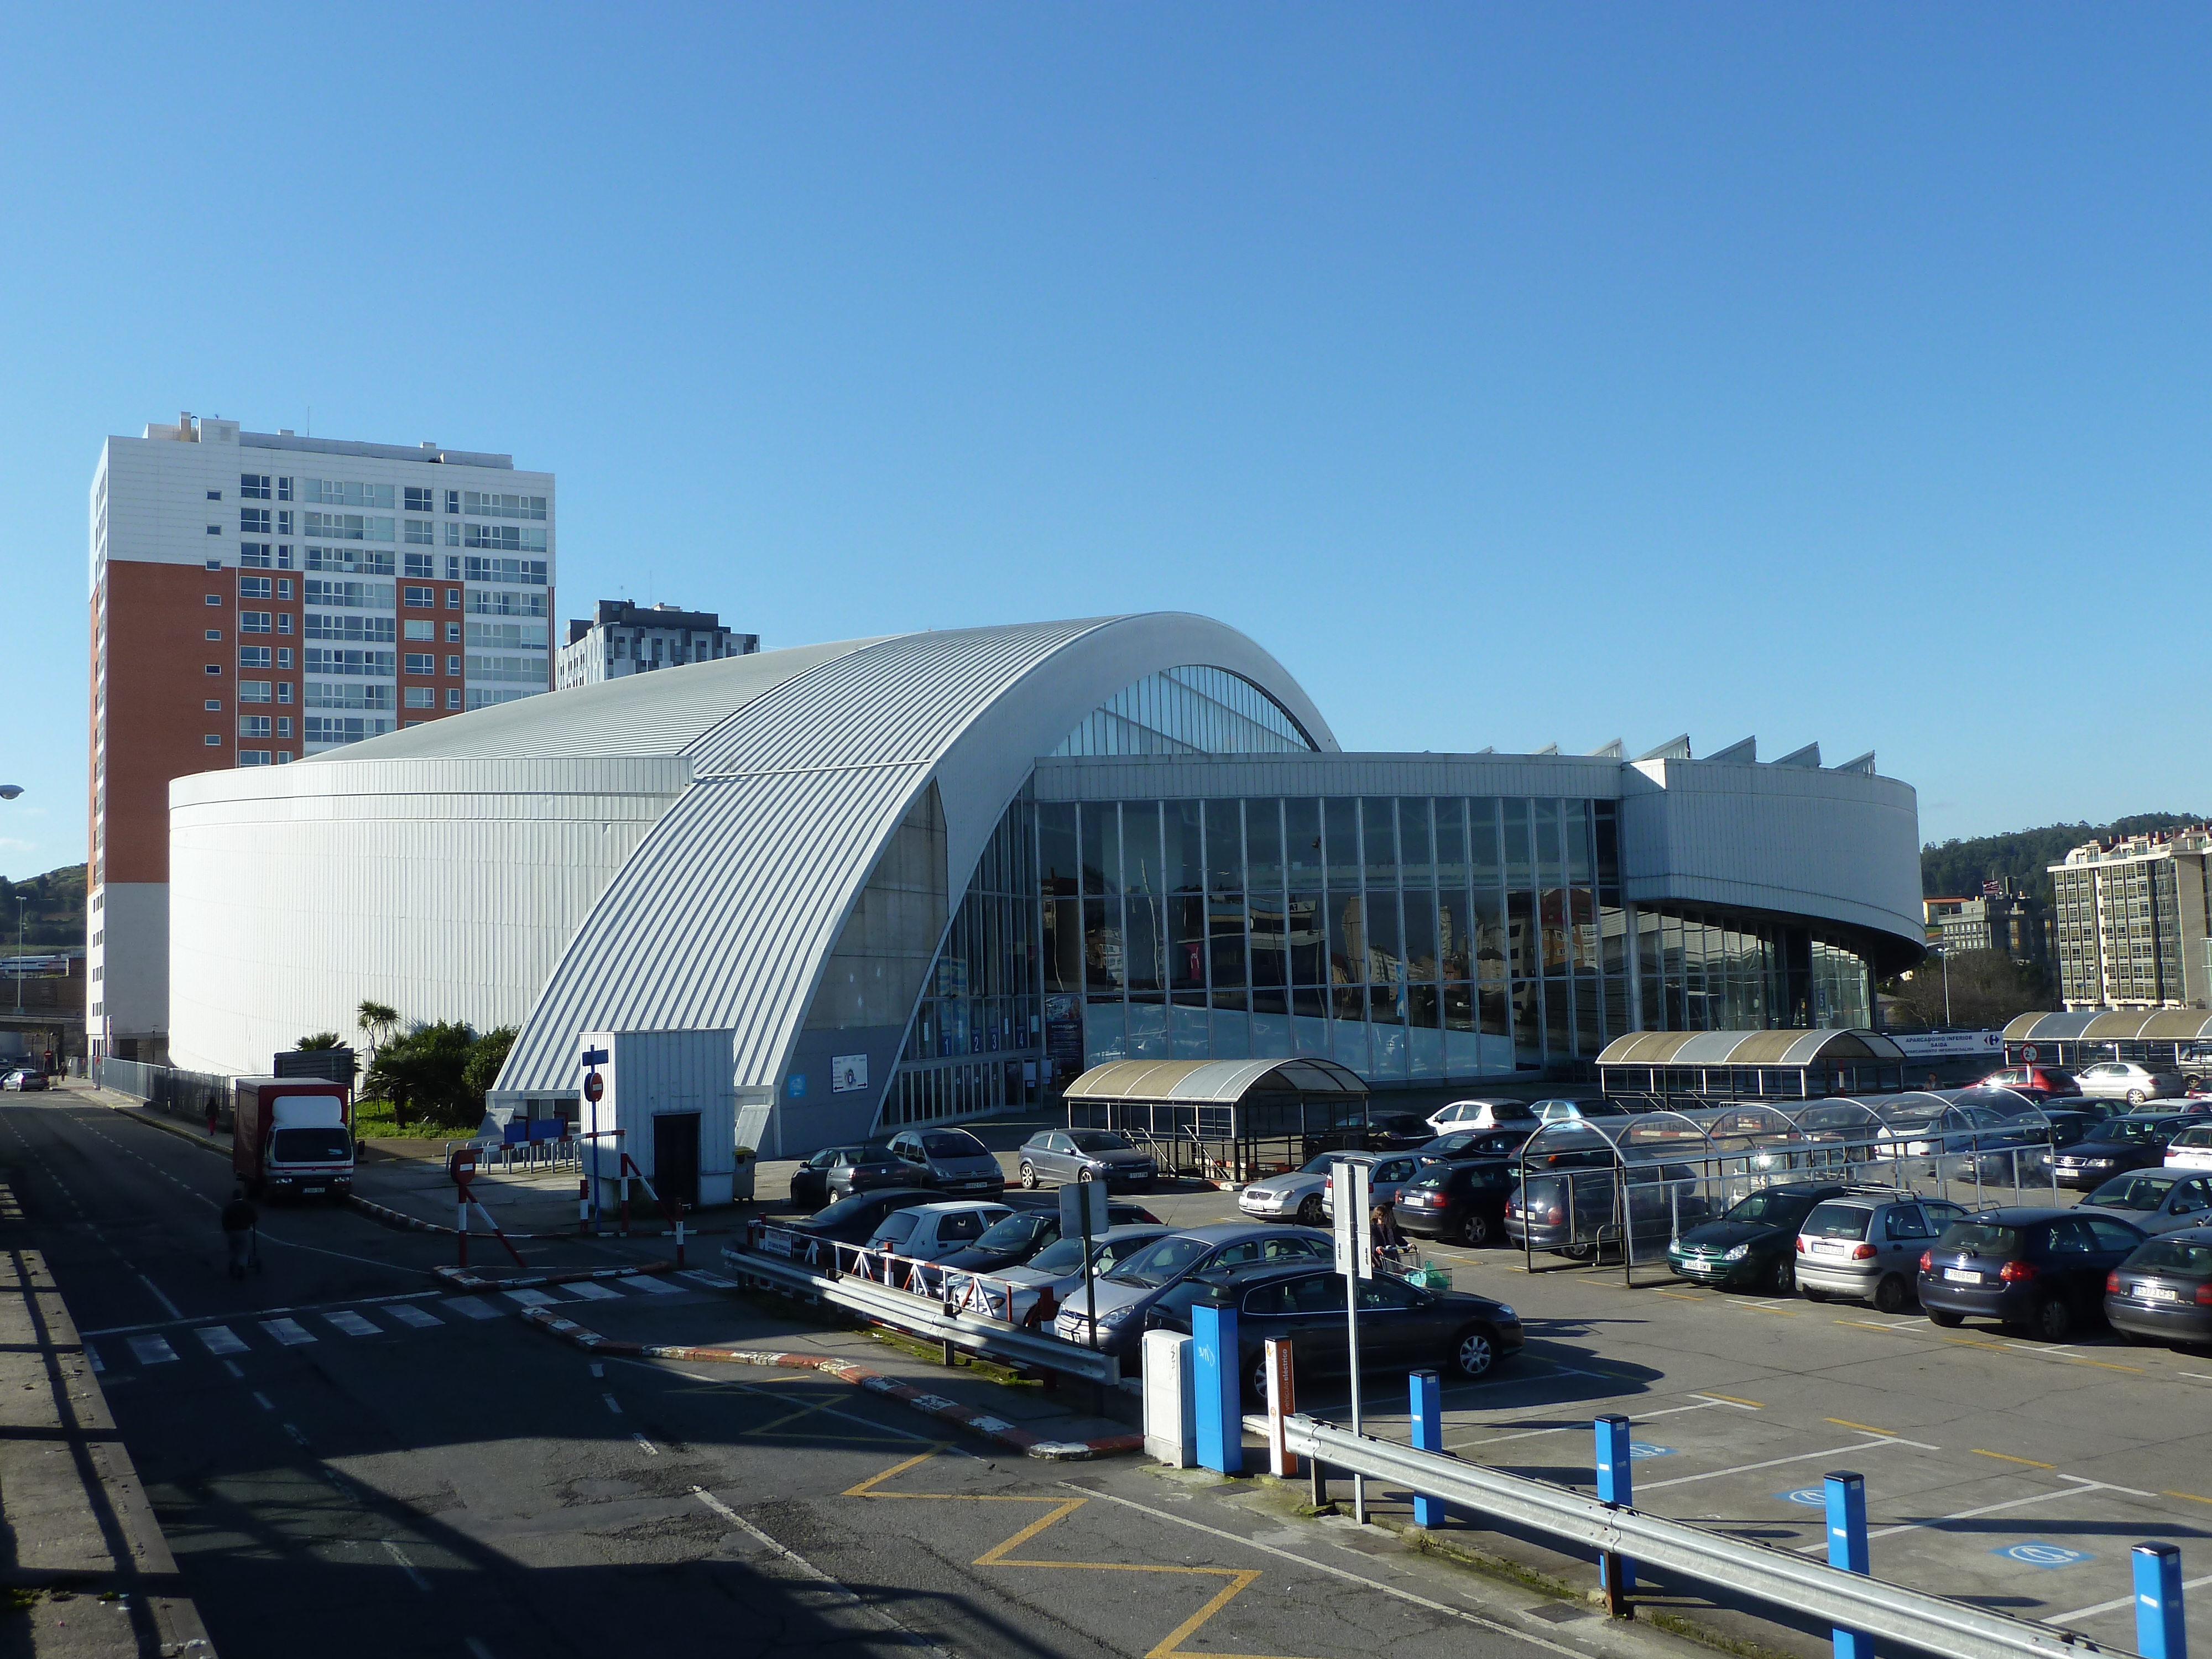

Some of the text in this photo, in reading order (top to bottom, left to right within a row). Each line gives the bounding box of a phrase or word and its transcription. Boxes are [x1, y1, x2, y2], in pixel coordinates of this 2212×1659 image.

[1820, 995, 1824, 1006] 5
[945, 1039, 949, 1055] 1
[974, 1036, 979, 1052] 2
[992, 1034, 997, 1050] 3
[1019, 1032, 1024, 1047] 4
[1949, 1270, 1965, 1280] 7666
[2139, 1287, 2173, 1298] 5373 CFS
